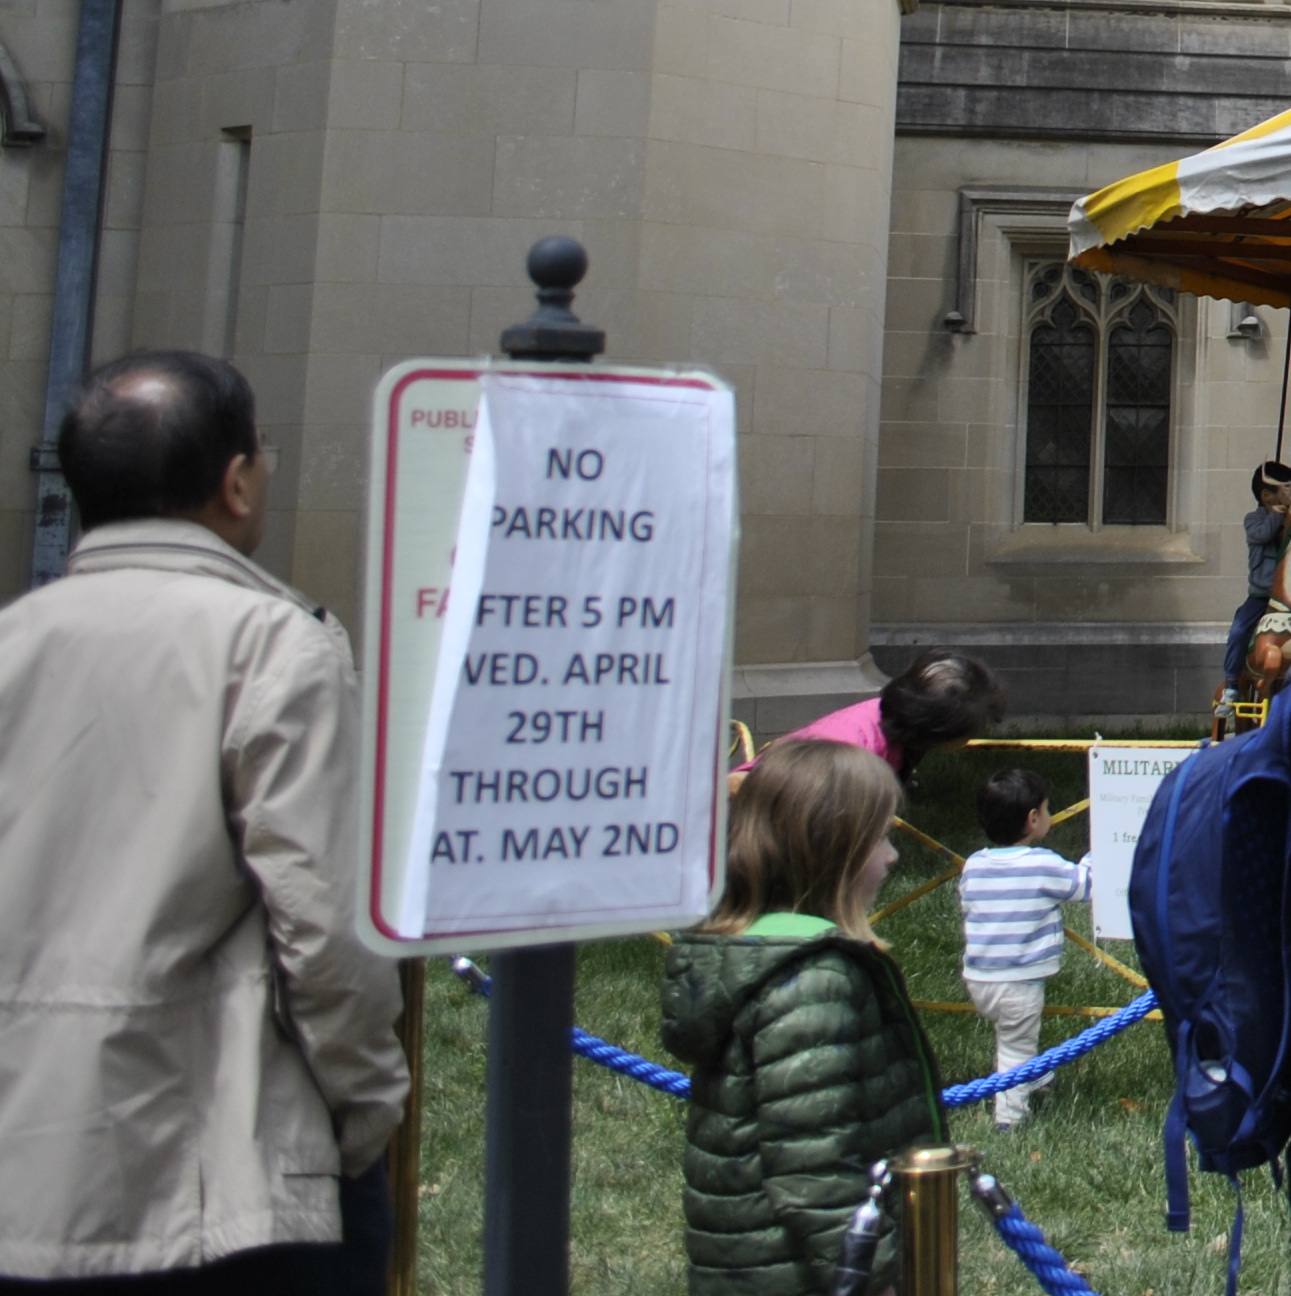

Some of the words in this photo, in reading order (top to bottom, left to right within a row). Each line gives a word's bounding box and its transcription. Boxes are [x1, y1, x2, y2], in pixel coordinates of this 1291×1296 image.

[546, 447, 605, 481] NO
[476, 594, 568, 629] FTER
[581, 596, 603, 629] 5
[617, 596, 676, 629] PM
[562, 652, 670, 686] APRIL
[506, 710, 605, 744] 29TH
[1103, 760, 1178, 775] MILITAR
[450, 766, 648, 804] THROUGH
[430, 830, 485, 864] AT.
[501, 825, 591, 862] MAY
[602, 821, 680, 857] 2ND
[1122, 831, 1138, 843] fre
